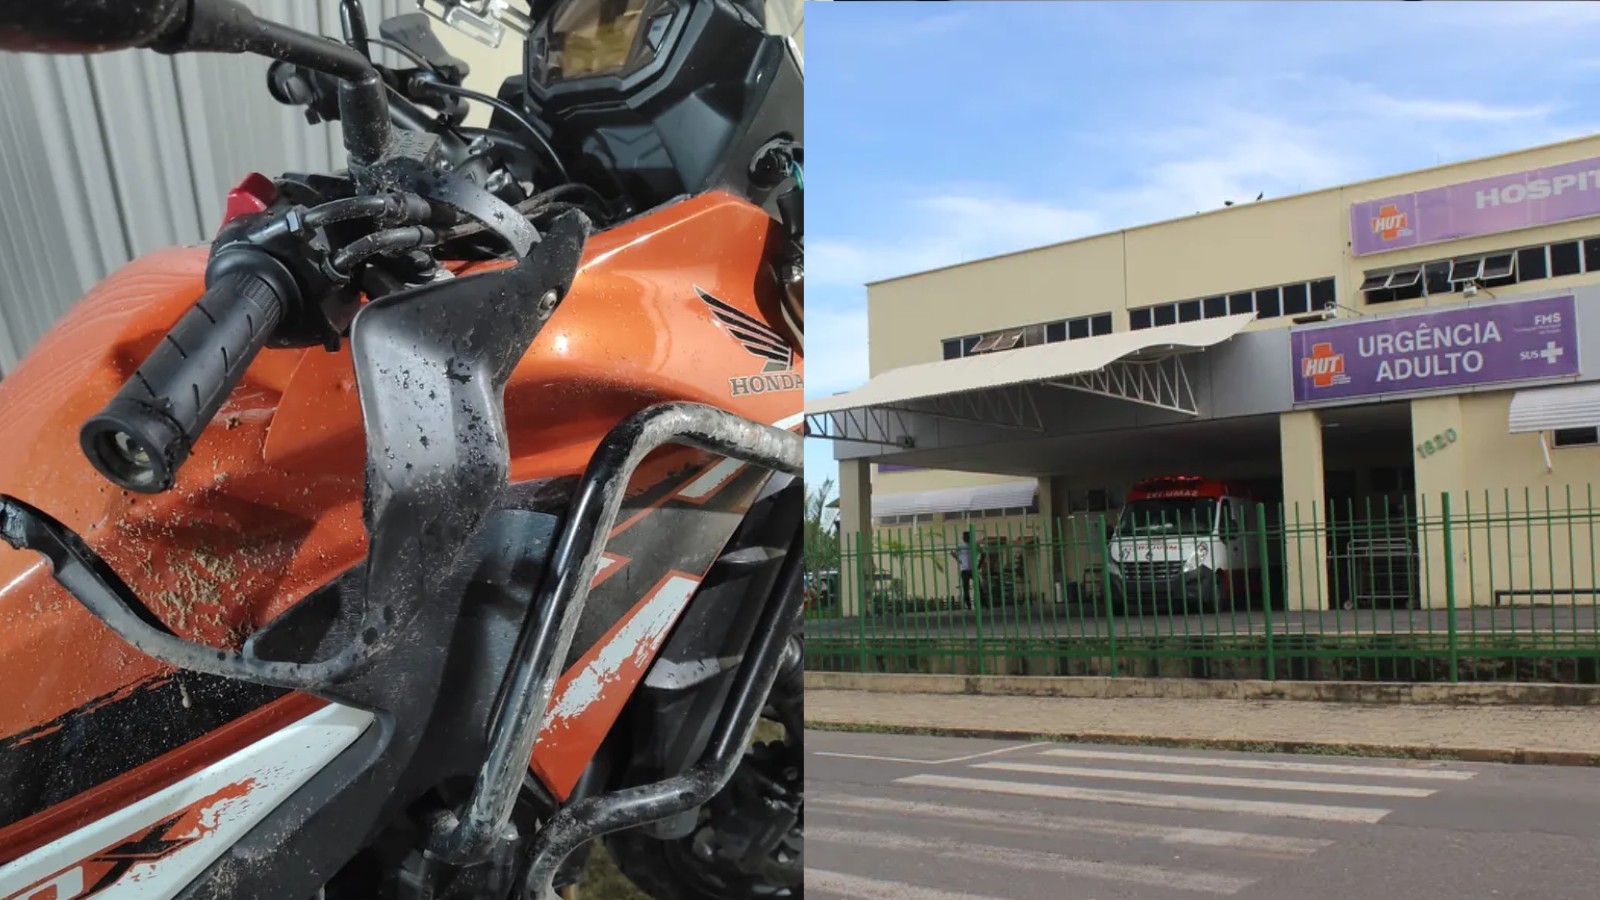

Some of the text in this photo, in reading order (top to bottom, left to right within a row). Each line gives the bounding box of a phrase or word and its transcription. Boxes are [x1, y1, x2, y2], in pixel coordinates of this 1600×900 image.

[1374, 213, 1404, 233] HUT
[1534, 312, 1561, 326] FMS
[1357, 321, 1502, 358] URGÊNCIA
[1305, 355, 1341, 377] HUT
[1376, 350, 1484, 383] ADULTO
[1519, 350, 1539, 361] SUS
[729, 374, 804, 396] HONDA
